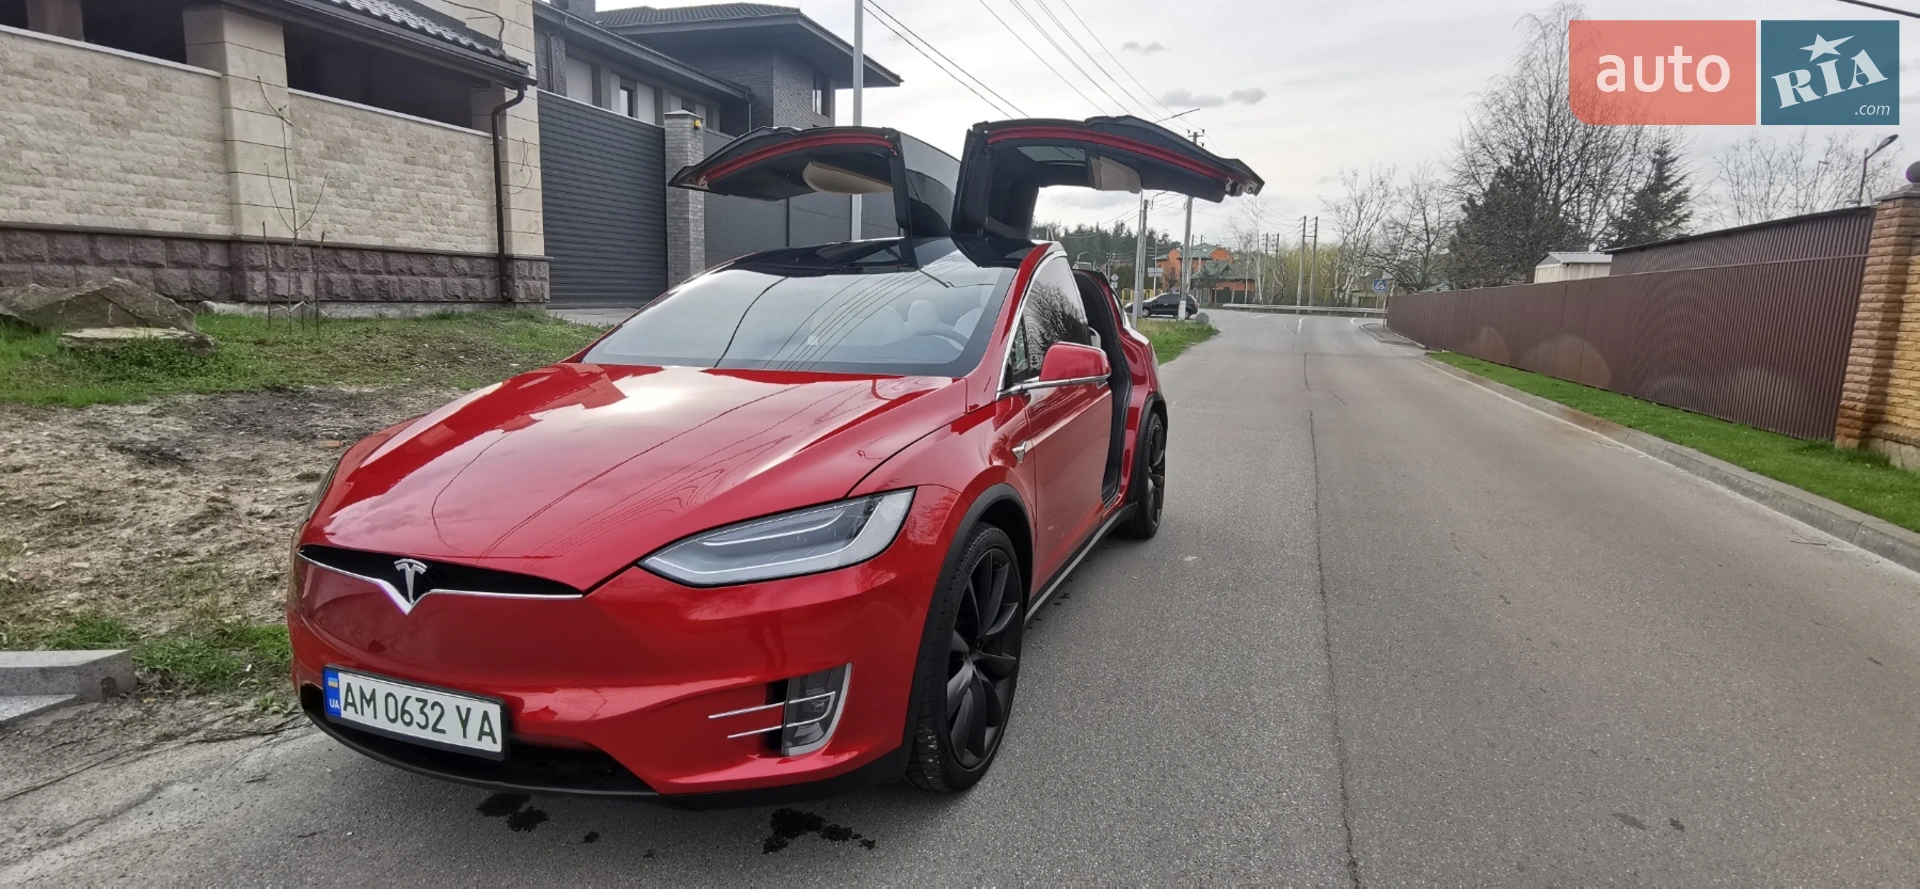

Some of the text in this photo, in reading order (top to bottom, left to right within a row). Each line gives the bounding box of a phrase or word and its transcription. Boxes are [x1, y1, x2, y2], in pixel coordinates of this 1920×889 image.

[329, 698, 340, 710] UA
[343, 682, 498, 745] AM 0632 YA
